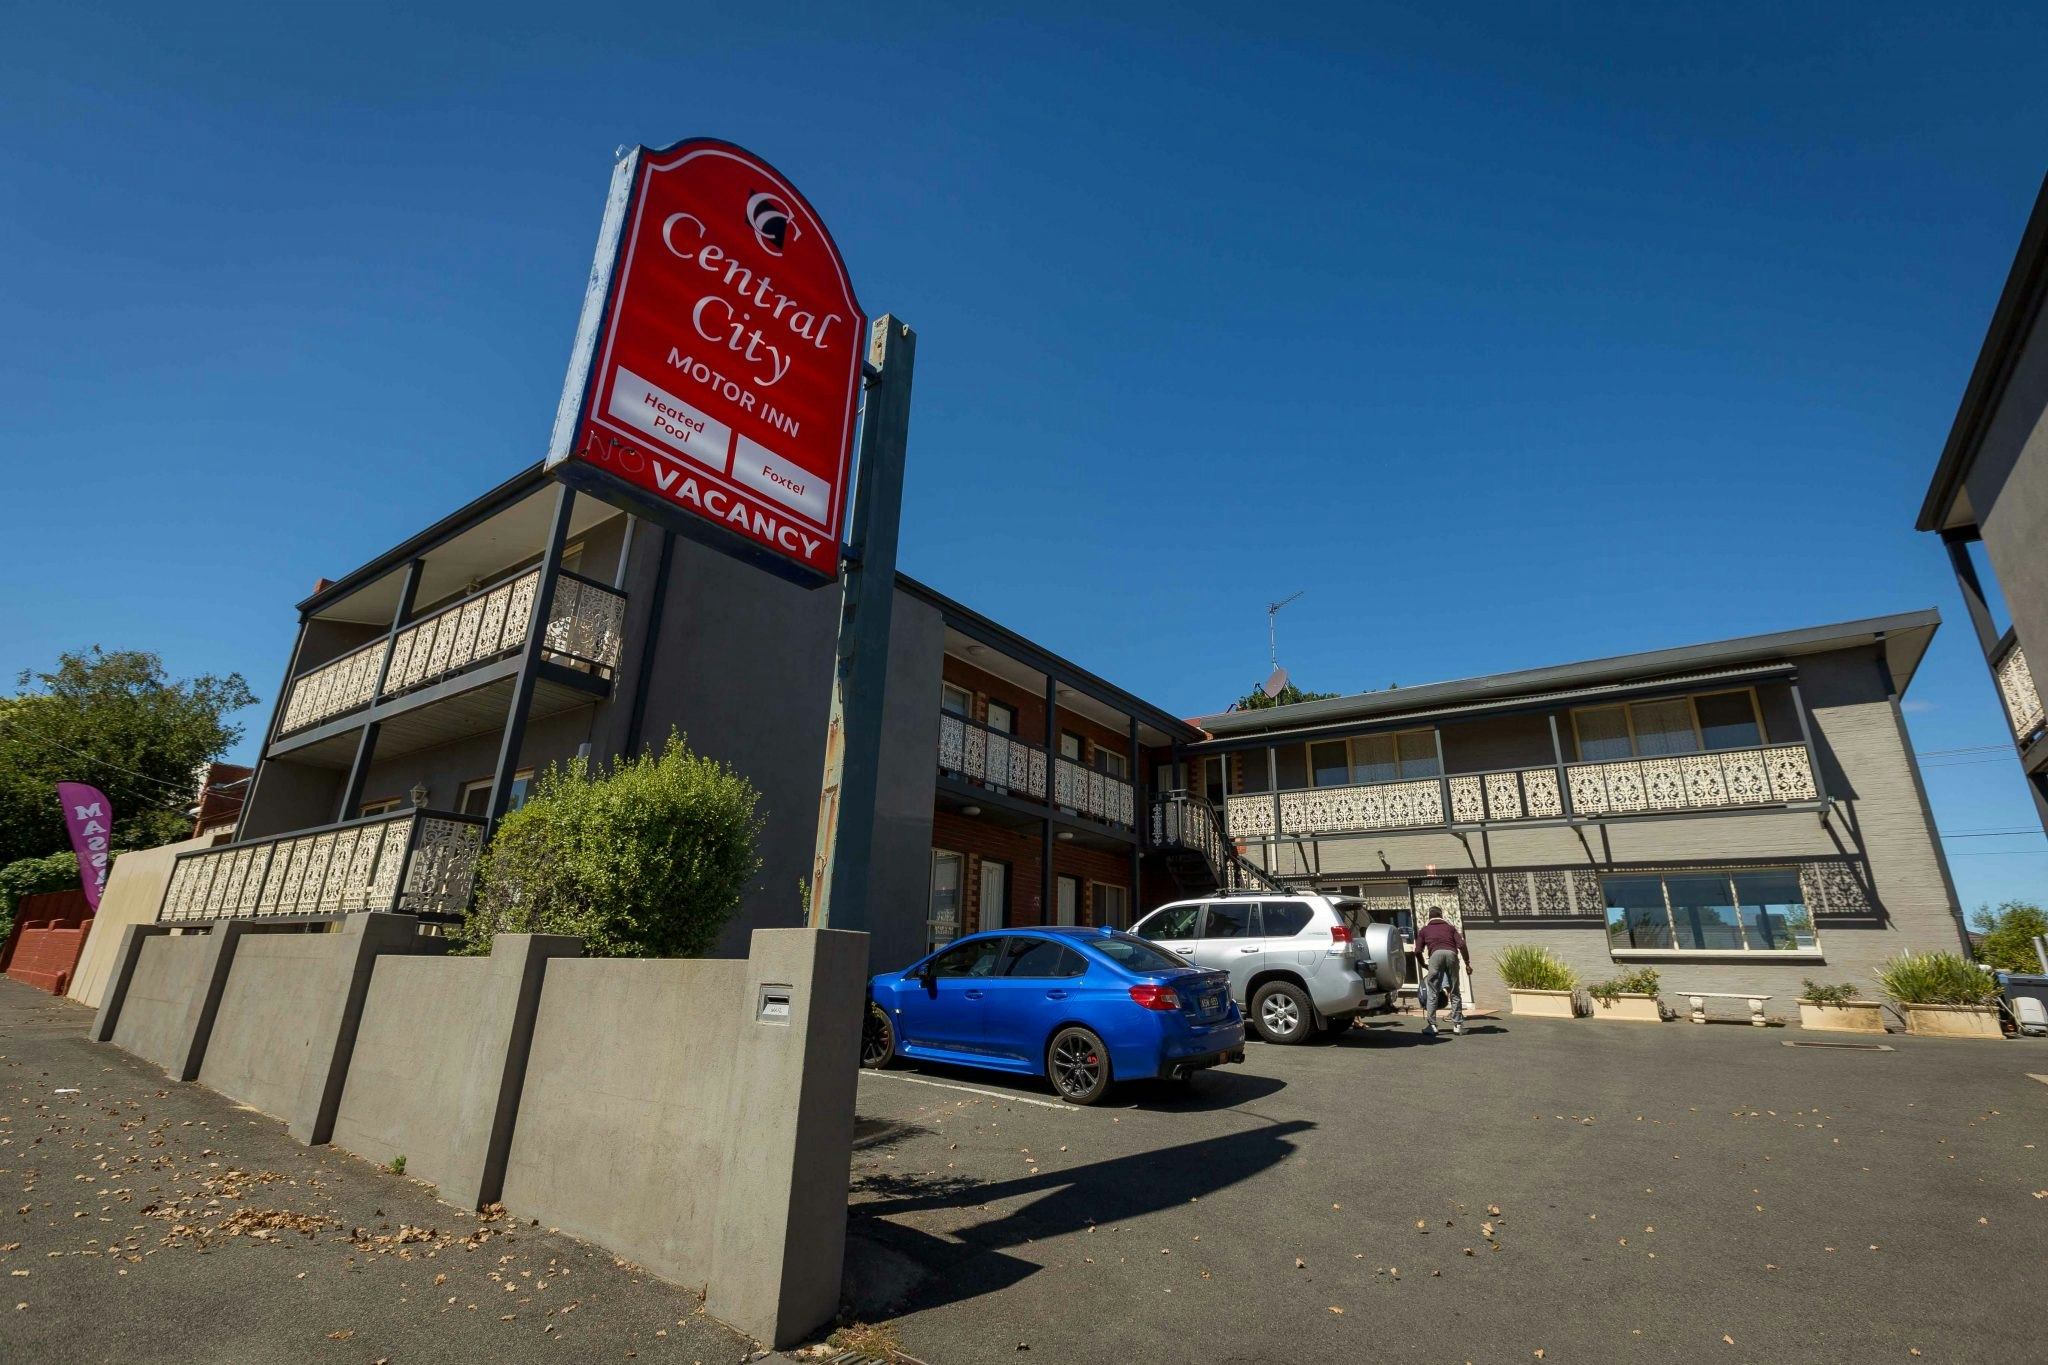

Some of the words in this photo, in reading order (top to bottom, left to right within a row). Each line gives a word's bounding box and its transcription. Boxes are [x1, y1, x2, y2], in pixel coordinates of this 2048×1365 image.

[662, 212, 842, 348] Central
[692, 295, 791, 386] City
[644, 392, 705, 434] Heated
[653, 415, 691, 442] Pool
[666, 346, 756, 412] MOTOR
[760, 403, 800, 438] INN
[652, 460, 821, 559] VACANCY
[762, 465, 806, 496] Foxtel
